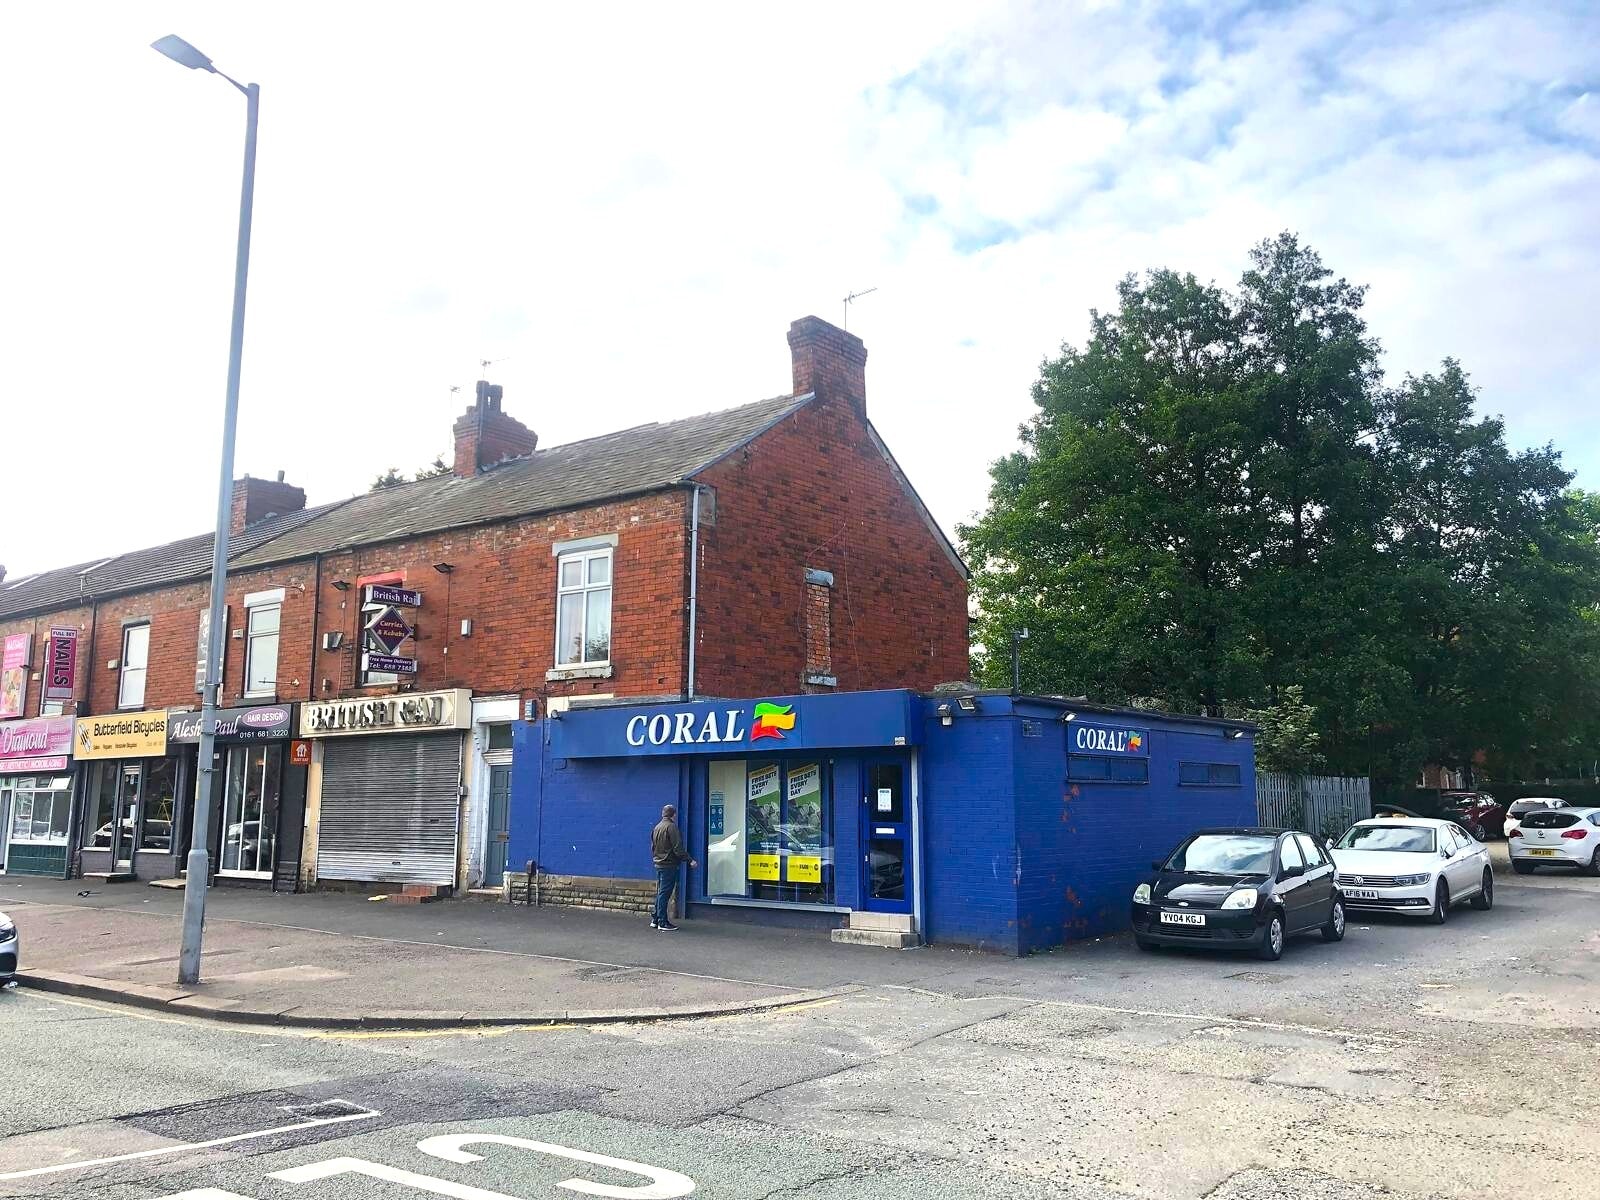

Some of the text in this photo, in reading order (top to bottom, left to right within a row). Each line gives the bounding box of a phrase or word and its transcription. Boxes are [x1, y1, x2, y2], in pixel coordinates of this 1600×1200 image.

[374, 590, 416, 605] British Raj
[54, 639, 70, 686] NAILS
[248, 713, 284, 722] HAIR DESIGN
[308, 702, 396, 730] BRITISH
[94, 718, 165, 736] Butterfield Bicycles
[169, 718, 202, 740] Alesh
[626, 710, 744, 746] CORAL
[1076, 728, 1126, 752] CORAL
[752, 775, 765, 784] FREE
[765, 770, 777, 780] BETS
[790, 775, 804, 784] FREE
[804, 770, 816, 779] BETS
[751, 780, 769, 790] EVERY
[790, 780, 808, 790] EVERY
[790, 788, 802, 796] DAY
[1164, 914, 1202, 924] YV04 KGJ
